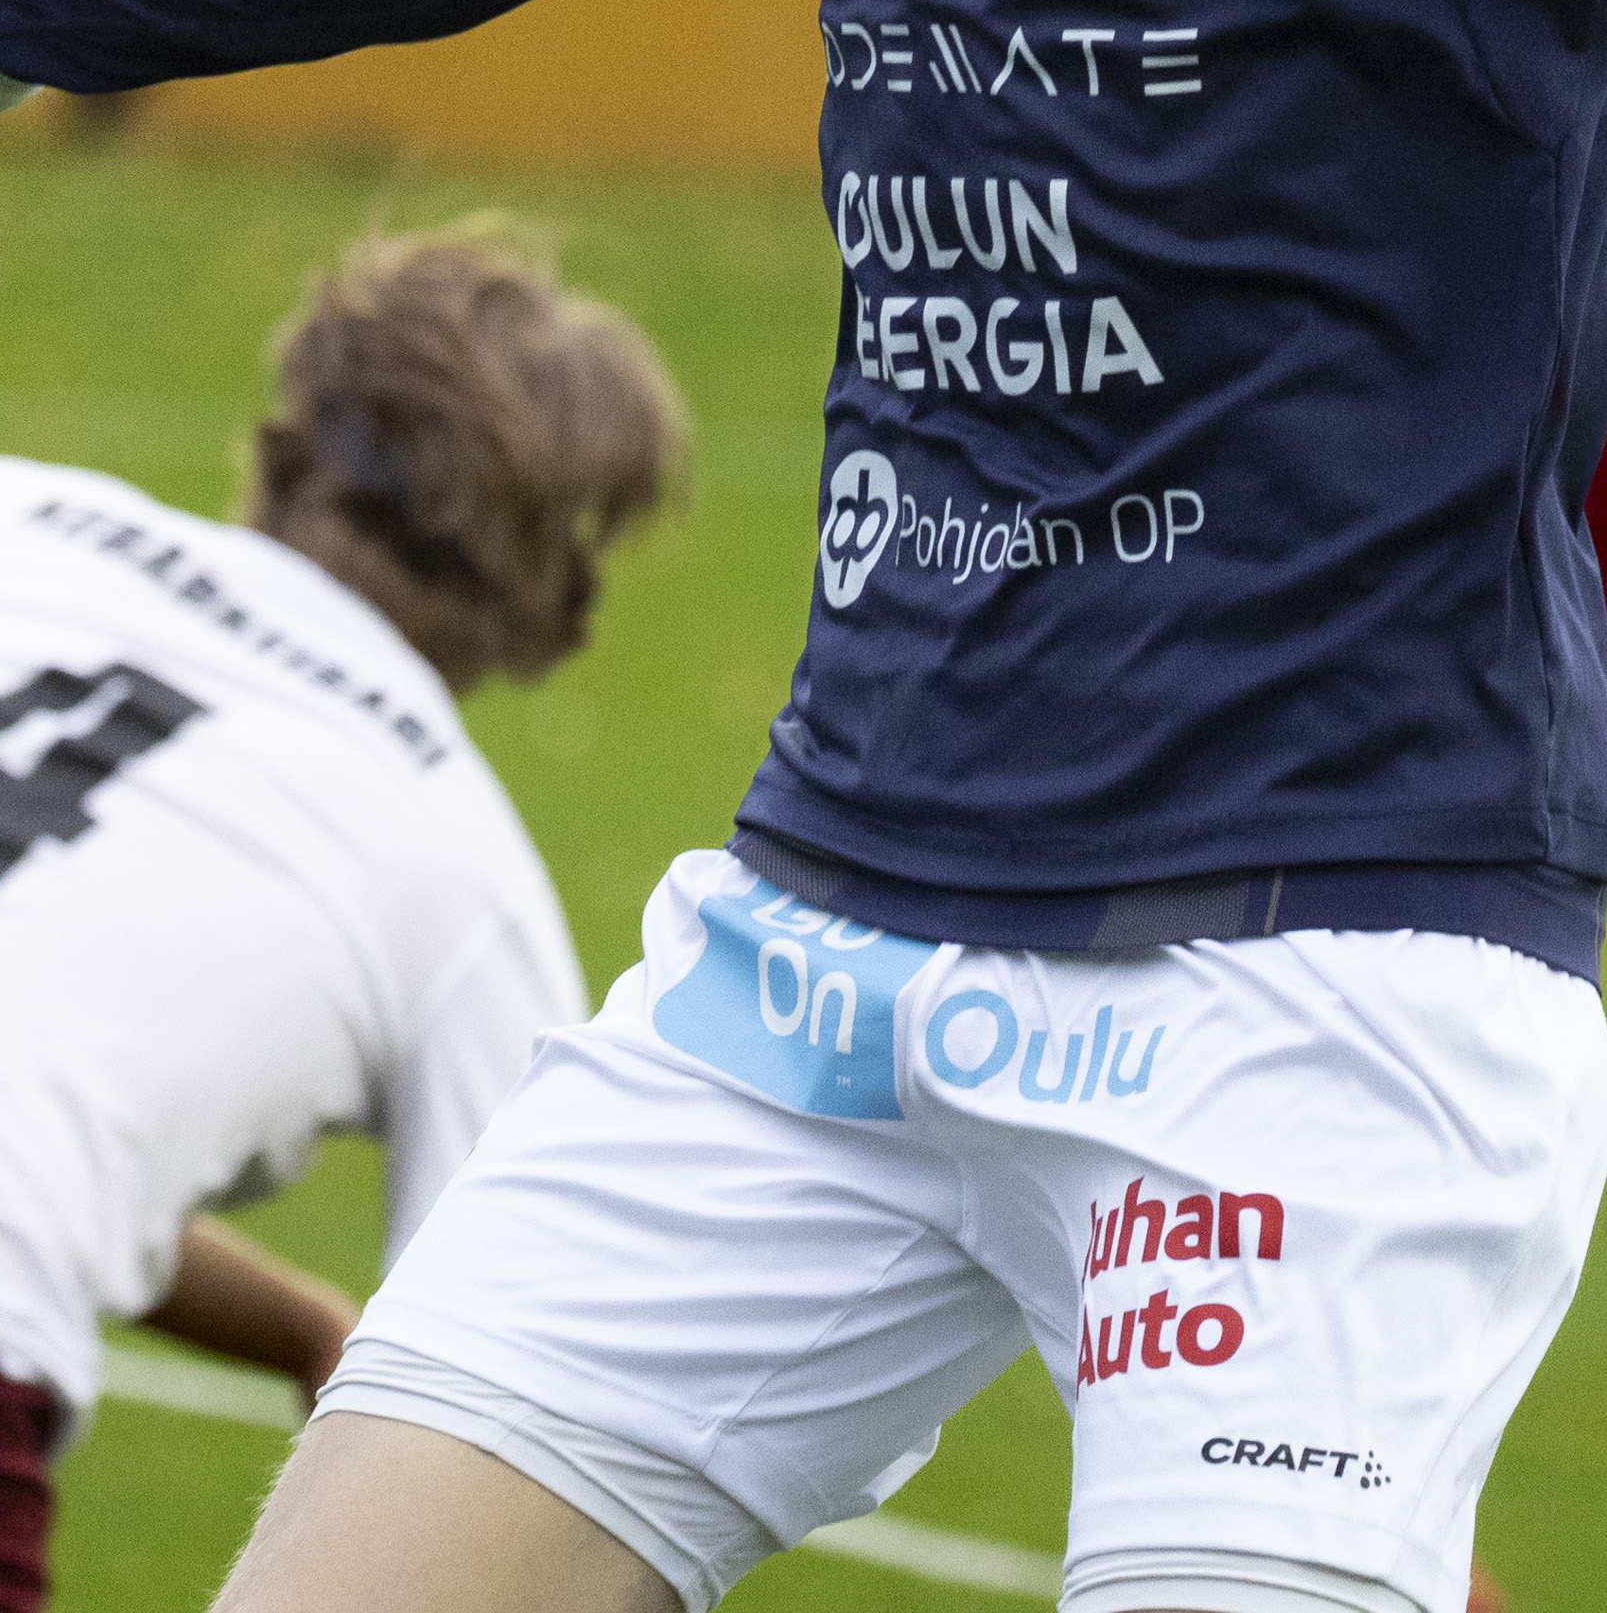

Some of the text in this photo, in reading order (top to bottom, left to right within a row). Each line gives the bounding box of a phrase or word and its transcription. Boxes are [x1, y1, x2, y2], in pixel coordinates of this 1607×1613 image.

[837, 170, 1078, 275] OULUN
[895, 488, 1206, 585] Pohjolan OP
[757, 937, 1167, 1105] On Oulu
[1076, 1288, 1245, 1402] Auto
[1200, 1437, 1360, 1479] CRAFT
